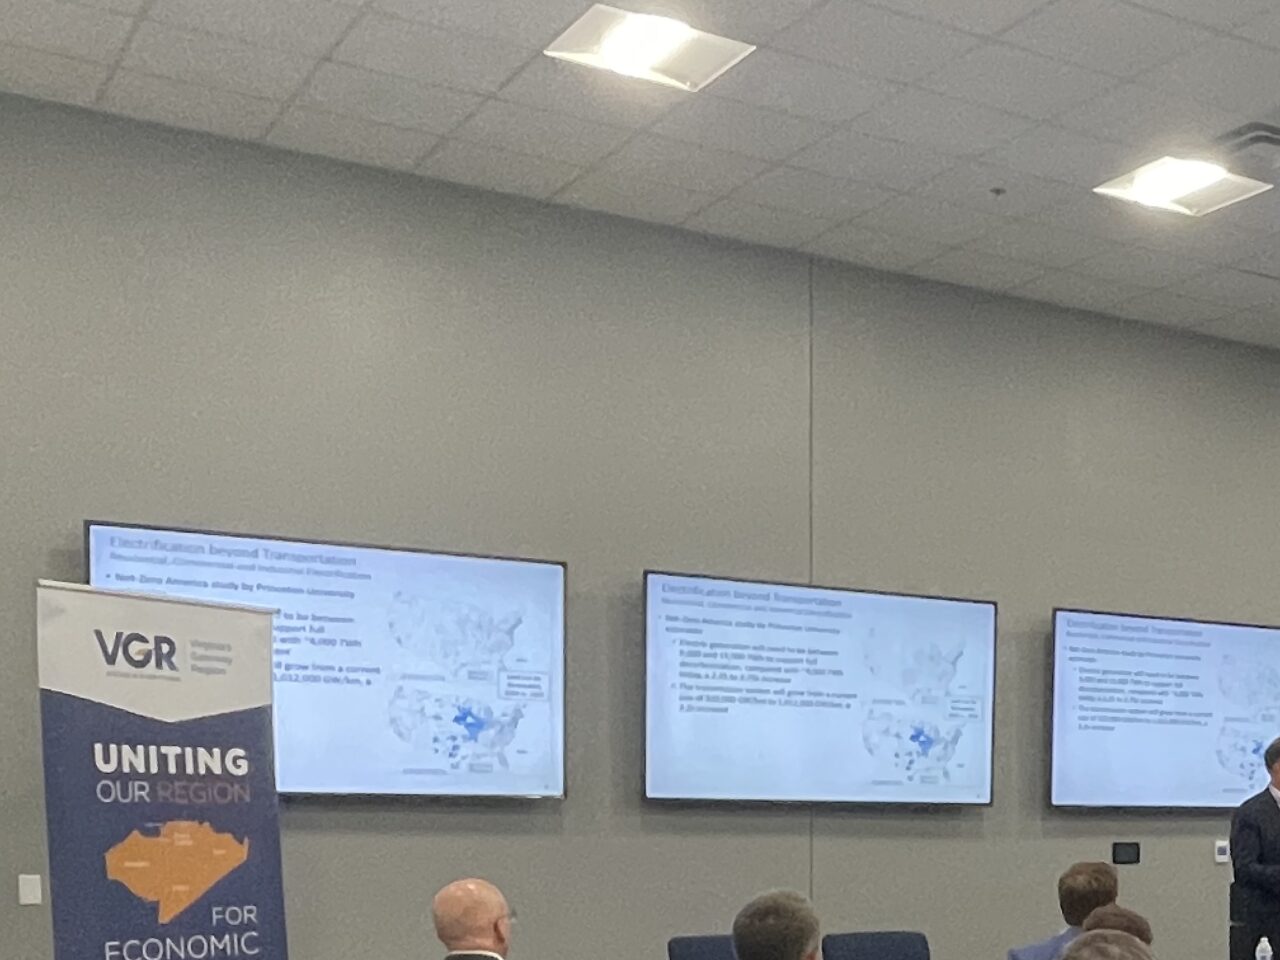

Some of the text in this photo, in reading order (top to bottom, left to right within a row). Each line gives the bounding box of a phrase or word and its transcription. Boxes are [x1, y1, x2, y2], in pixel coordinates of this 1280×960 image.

[209, 543, 259, 559] beyond
[93, 629, 180, 672] VGR
[94, 743, 249, 776] UNITING
[96, 779, 249, 804] OUR REGION
[211, 906, 258, 927] FOR
